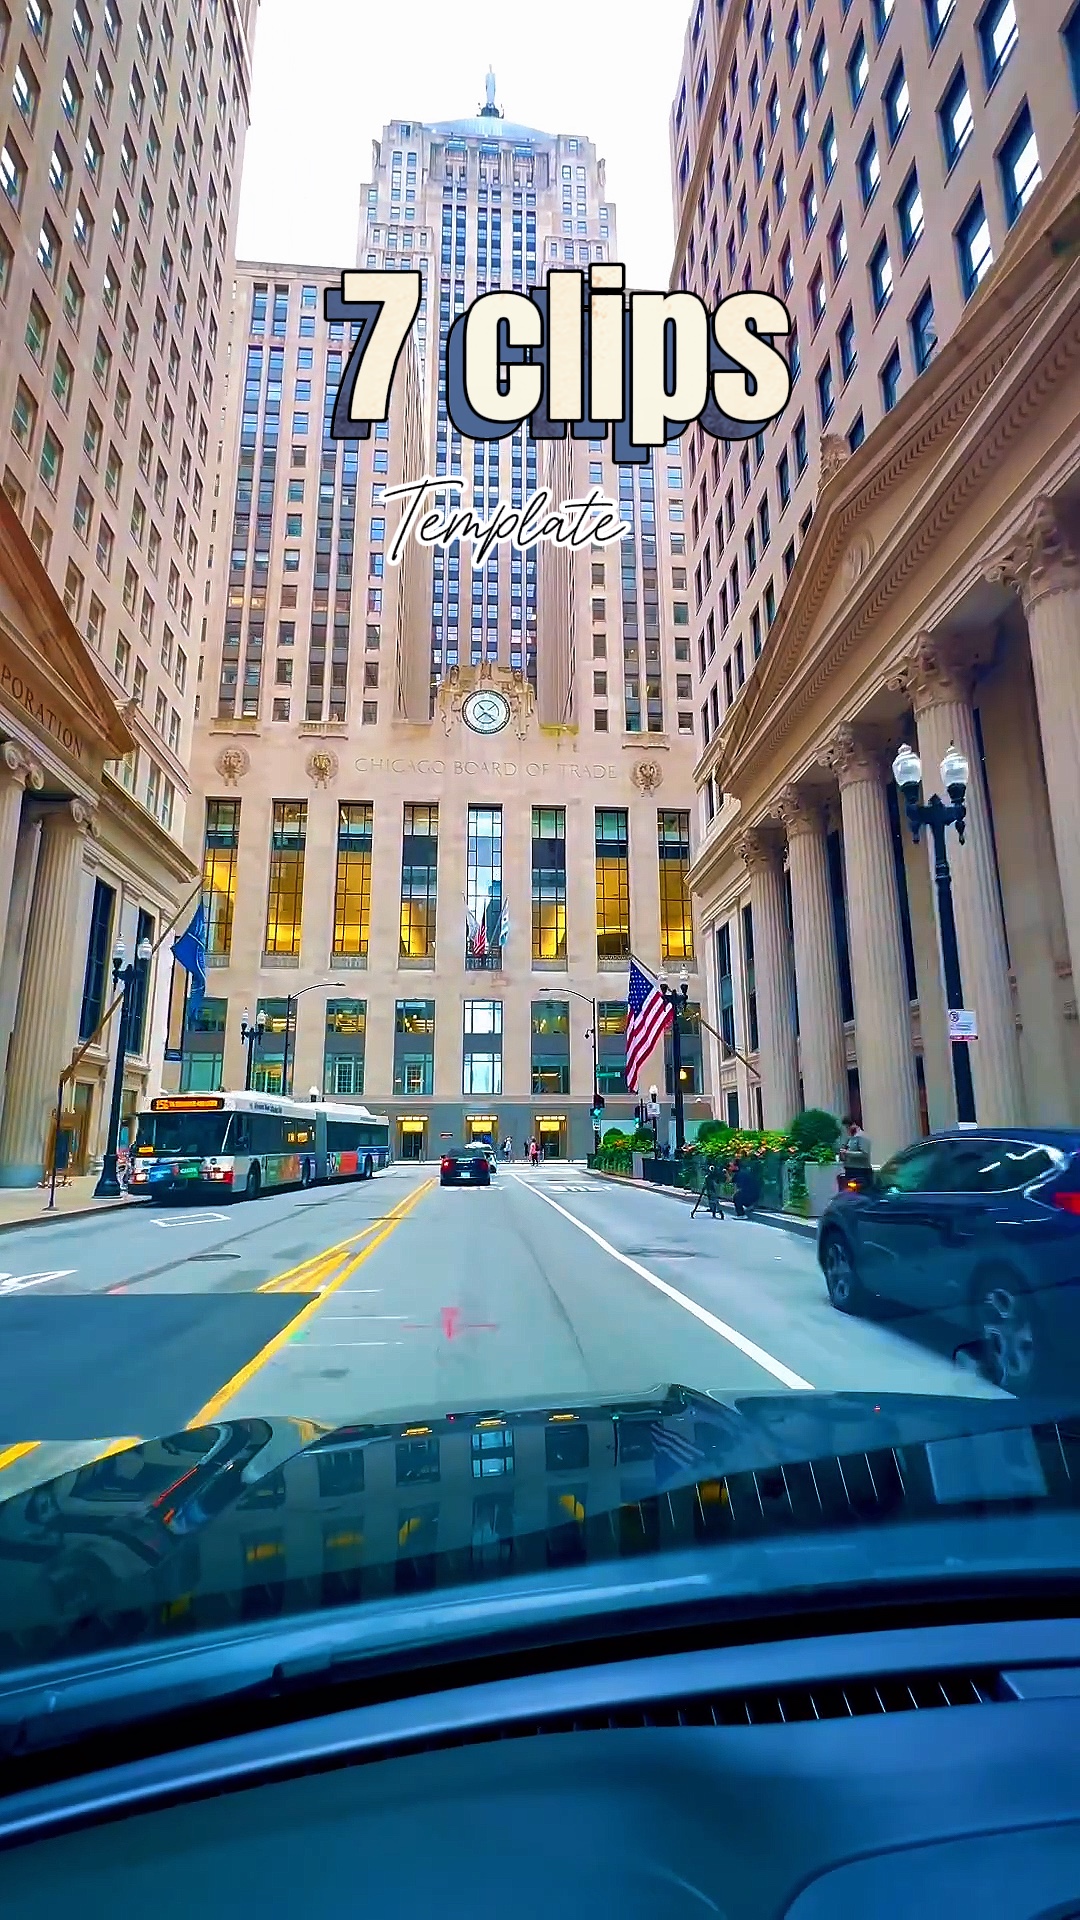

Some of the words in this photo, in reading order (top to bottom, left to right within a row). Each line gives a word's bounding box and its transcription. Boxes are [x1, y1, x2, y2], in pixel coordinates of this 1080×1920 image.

[354, 757, 446, 774] CHICAGO
[453, 760, 518, 777] BOARD
[525, 762, 550, 777] OF
[557, 763, 618, 779] TRADE
